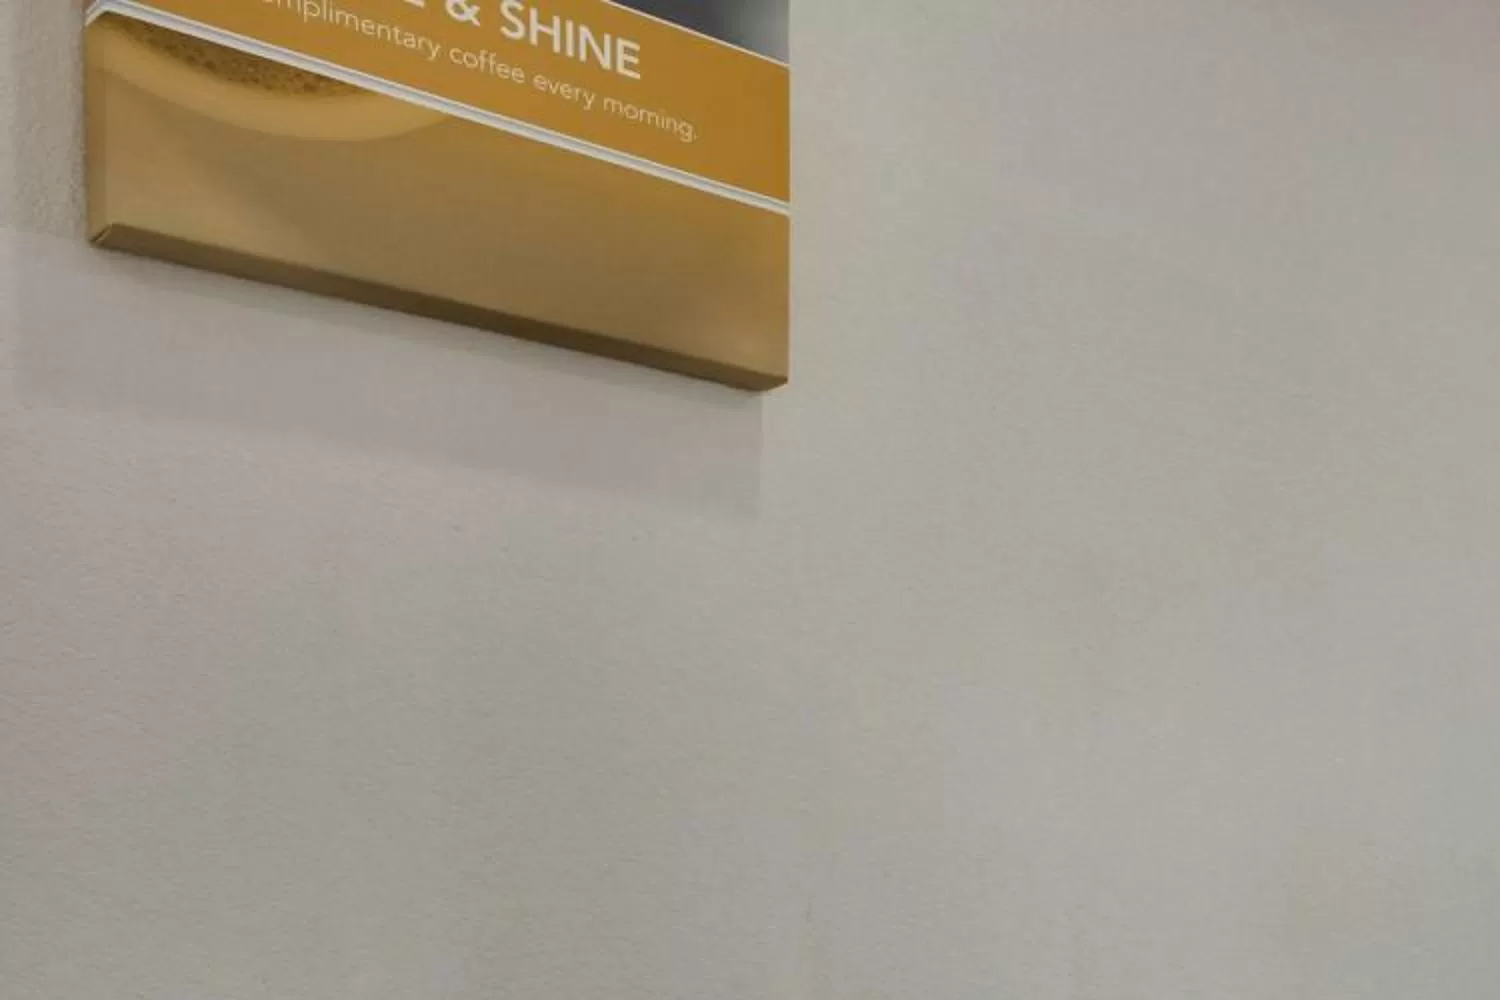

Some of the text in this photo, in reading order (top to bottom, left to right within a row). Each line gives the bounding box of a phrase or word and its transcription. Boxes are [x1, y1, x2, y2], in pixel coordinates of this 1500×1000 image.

[262, 0, 699, 144] mplimentary coffee every morning.
[500, 0, 641, 80] SHINE
